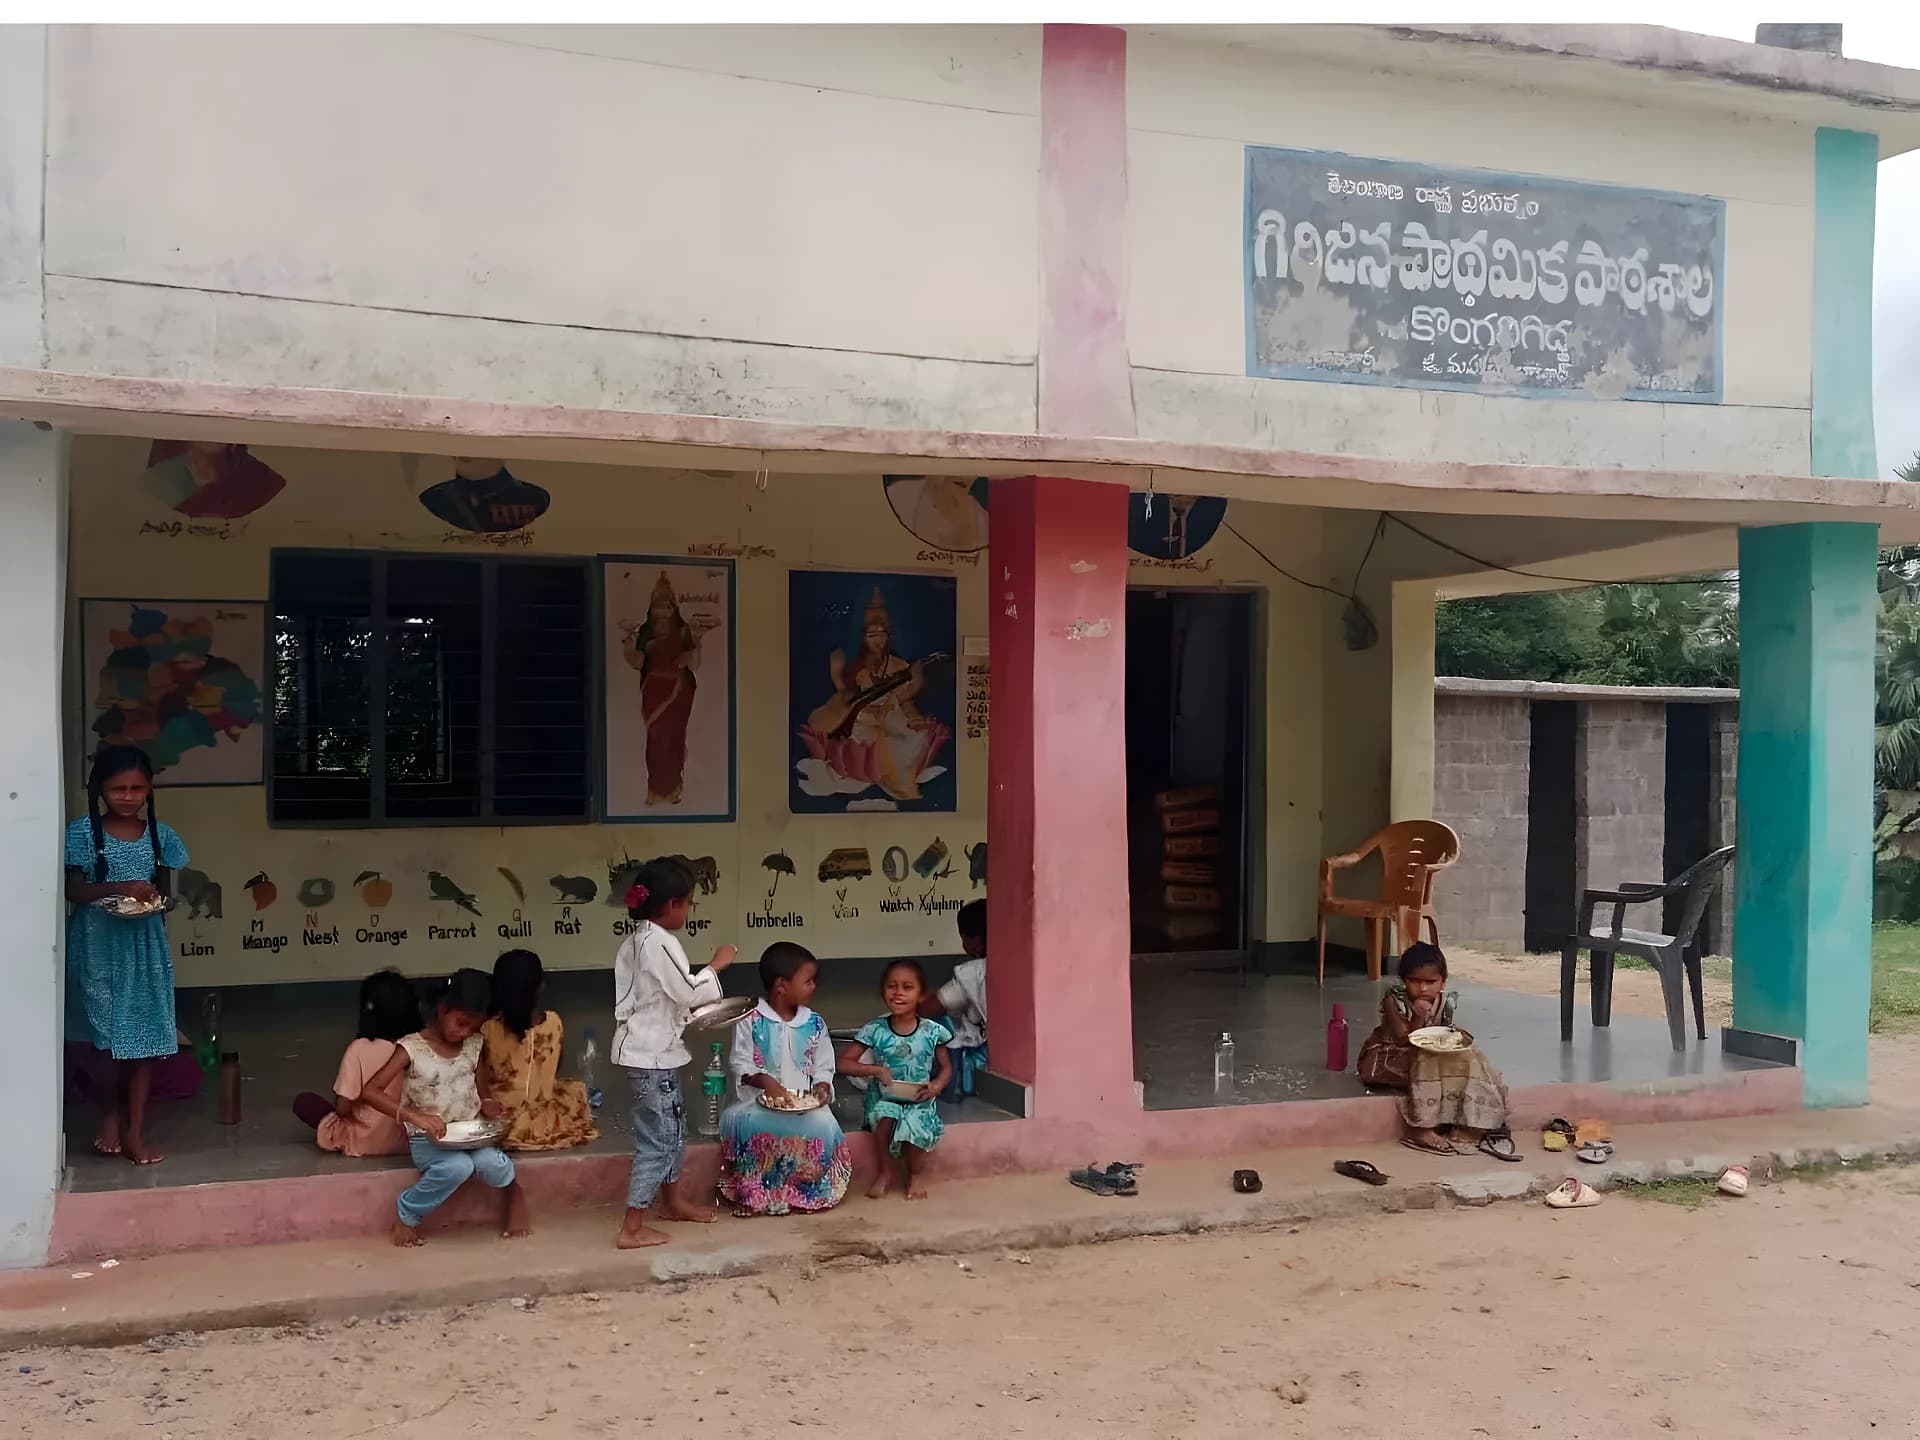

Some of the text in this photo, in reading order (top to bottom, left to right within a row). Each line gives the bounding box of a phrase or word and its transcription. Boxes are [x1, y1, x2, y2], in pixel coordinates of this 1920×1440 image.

[879, 896, 914, 912] Watch
[554, 917, 583, 936] Rat
[684, 915, 712, 937] iger
[746, 911, 804, 928] Umbrella
[302, 925, 340, 946] Nest
[355, 928, 408, 946] Orange
[427, 921, 478, 940] Parrot
[497, 920, 533, 939] Quill
[180, 941, 216, 957] Lion
[241, 934, 289, 954] Mango
